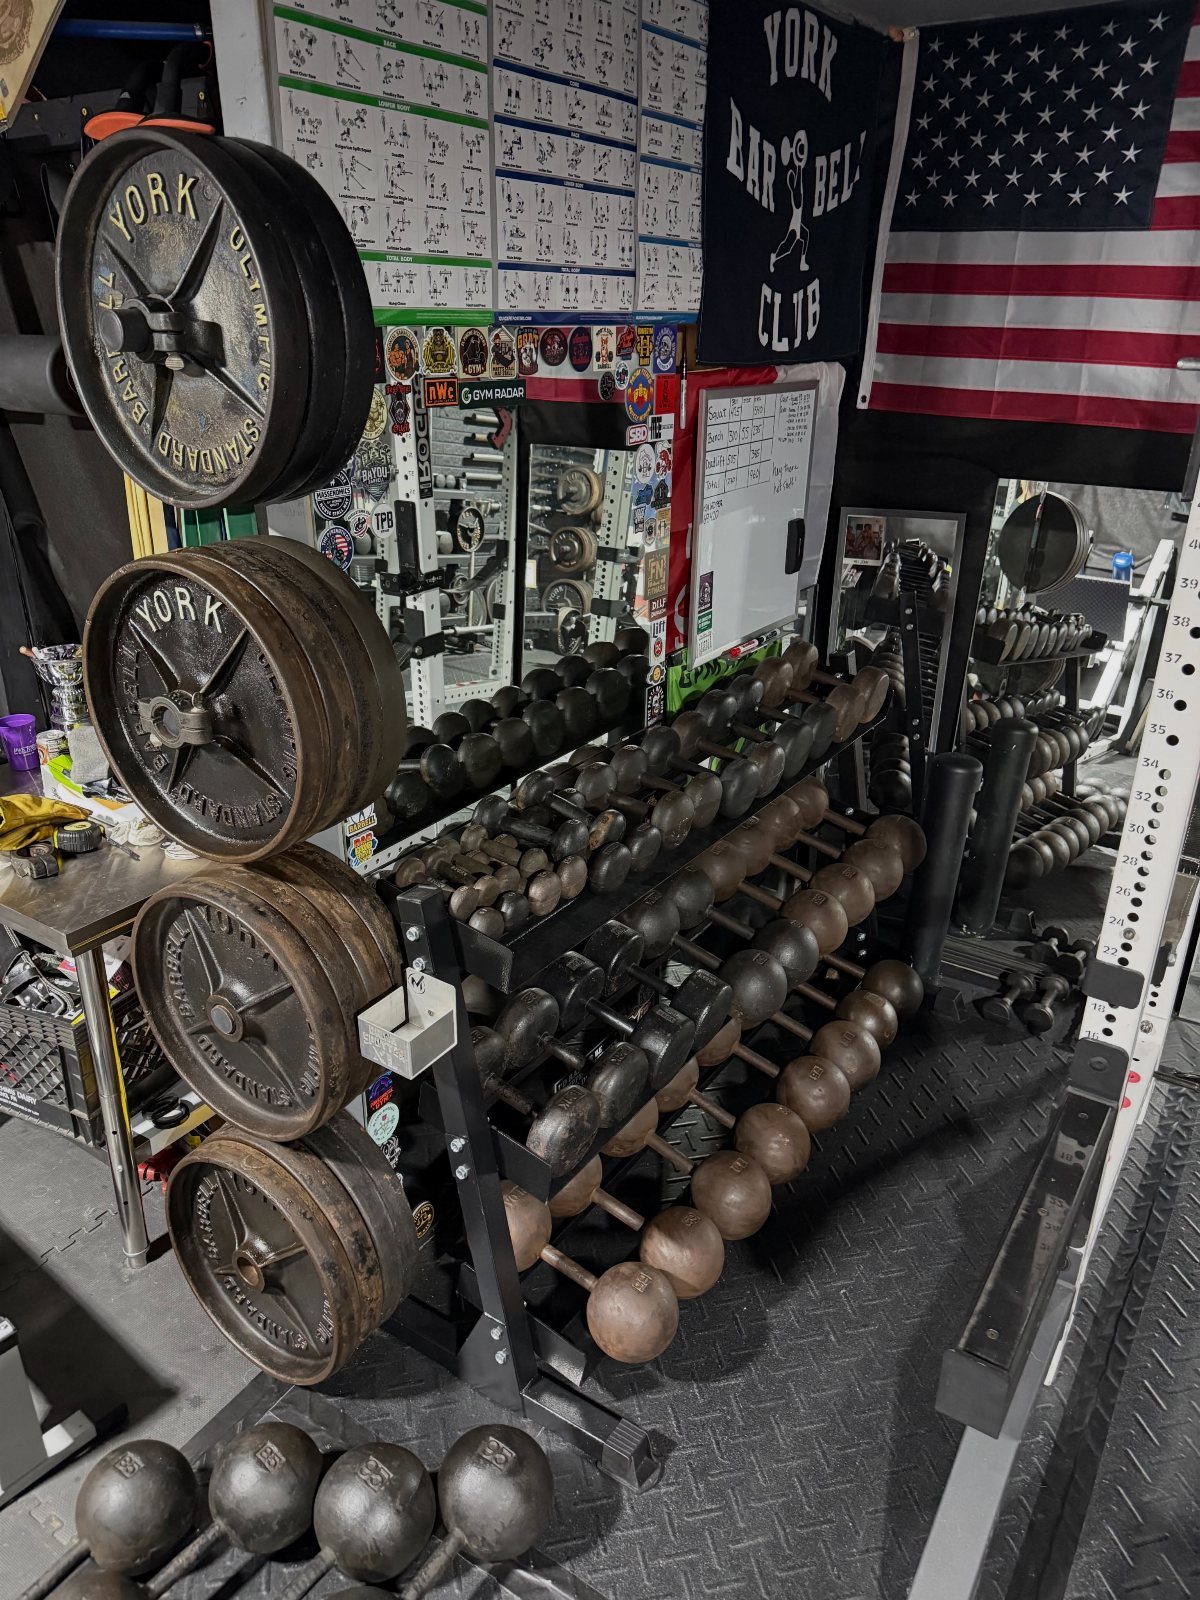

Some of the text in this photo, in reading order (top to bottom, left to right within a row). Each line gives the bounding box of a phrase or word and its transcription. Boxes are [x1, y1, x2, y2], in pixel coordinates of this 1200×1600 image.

[383, 40, 397, 49] BACK
[764, 7, 838, 102] YORK
[378, 100, 411, 112] LOWER BODY
[726, 96, 775, 213] BAR
[108, 172, 201, 242] YORK
[229, 225, 270, 391] OLYMPIC
[517, 333, 539, 349] GOAT
[468, 364, 482, 374] GYM
[429, 382, 454, 400] nWc
[473, 389, 493, 400] GYM
[494, 387, 524, 399] RADAR
[708, 406, 727, 422] Squat
[629, 426, 648, 443] SBD
[707, 430, 724, 444] Bench
[158, 417, 262, 473] STANDARD
[362, 466, 387, 483] BAYOU
[316, 487, 351, 499] MASSENOMICS
[374, 511, 394, 530] TPB
[1179, 577, 1198, 589] 39
[136, 586, 223, 633] YORK
[1171, 615, 1190, 627] 38
[652, 620, 666, 638] Lift
[1163, 652, 1182, 664] 37
[1156, 688, 1174, 700] 36
[1149, 723, 1167, 734] 35
[1142, 757, 1159, 768] 34
[1134, 790, 1151, 802] 32
[174, 781, 283, 829] STANDARD
[349, 815, 376, 834] BARBELL
[1127, 823, 1145, 834] 30
[1121, 855, 1138, 866] 28
[1115, 886, 1131, 897] 26
[1108, 915, 1124, 927] 24
[1102, 946, 1118, 957] 22
[165, 920, 195, 1018] BARBELL
[1090, 1002, 1106, 1013] 18
[197, 1034, 292, 1107] STANDARD
[16, 1090, 37, 1105] DAIRY
[196, 1176, 220, 1261] BARBELL
[223, 1276, 308, 1350] STANDARD
